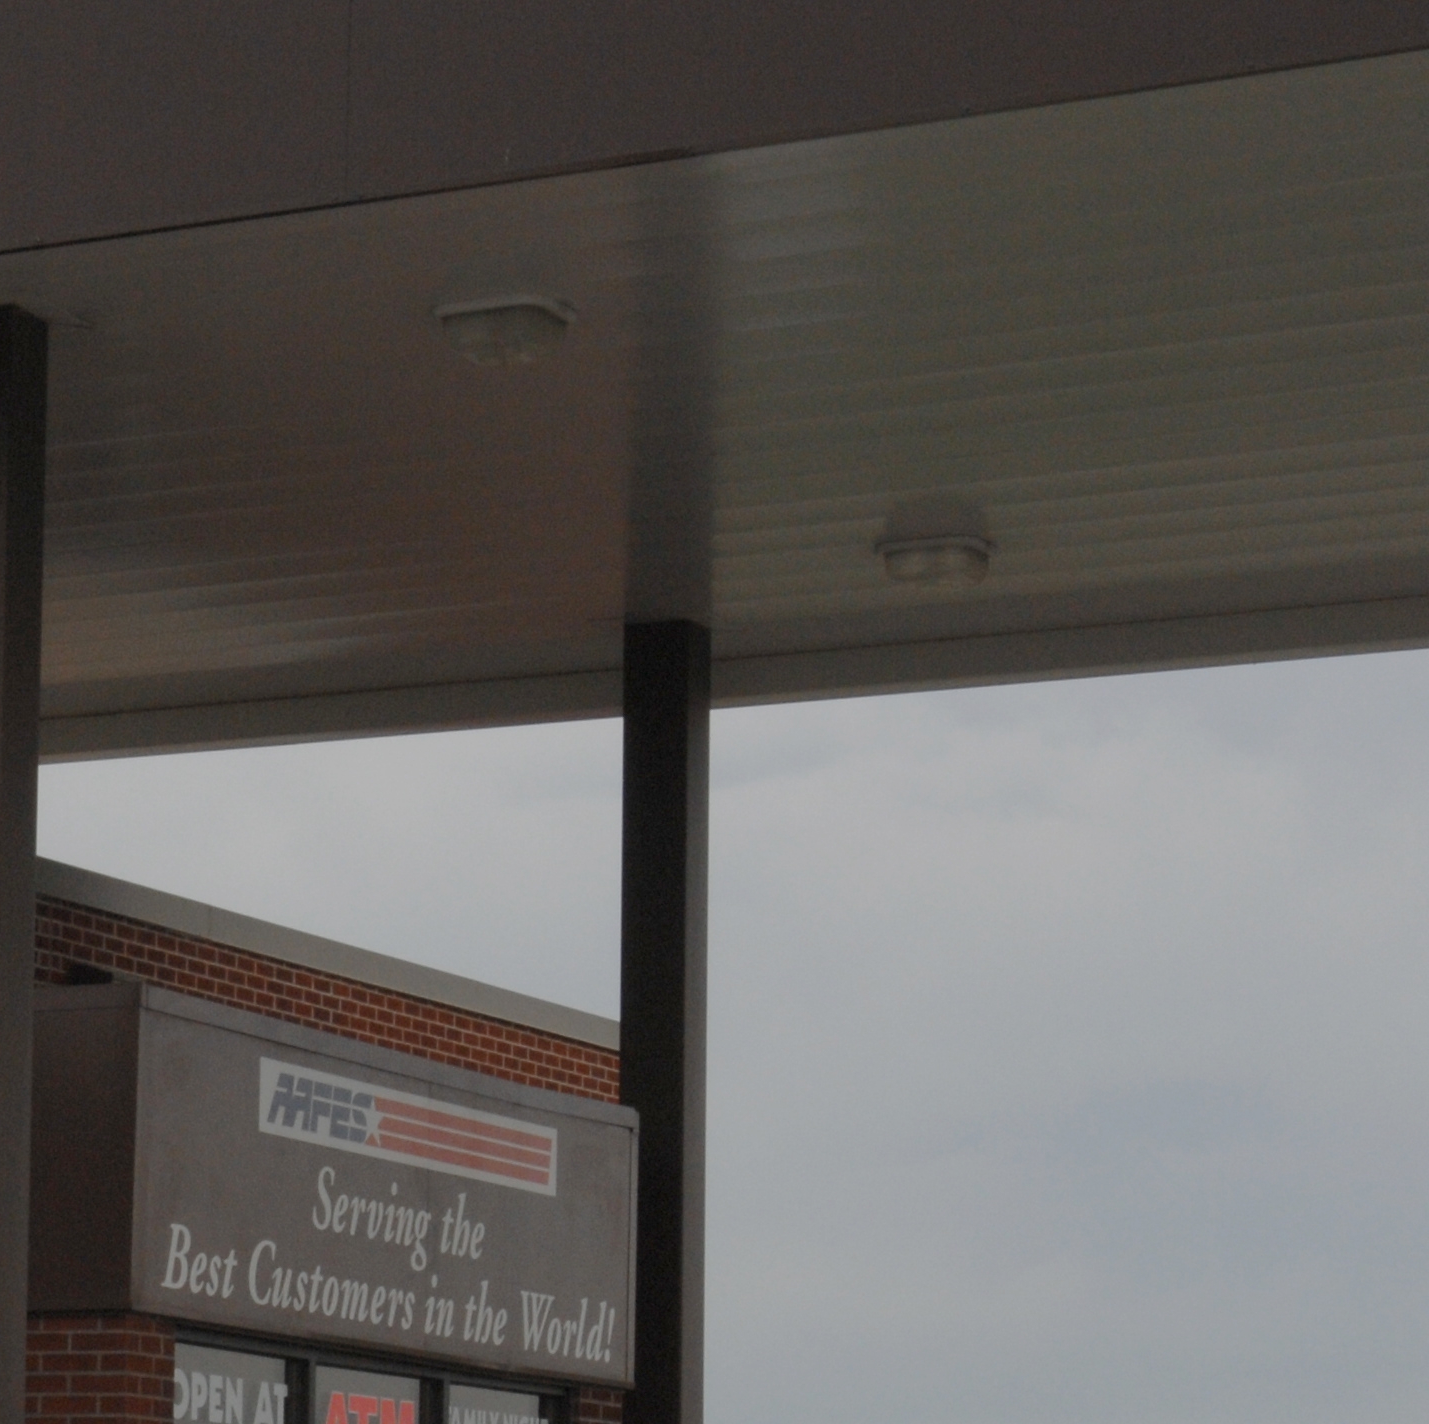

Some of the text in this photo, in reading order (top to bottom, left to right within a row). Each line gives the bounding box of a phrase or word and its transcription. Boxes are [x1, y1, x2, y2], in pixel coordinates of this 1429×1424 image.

[266, 1072, 375, 1144] AAFES
[312, 1166, 486, 1271] Serving the
[161, 1224, 617, 1363] Best Customers in the World!
